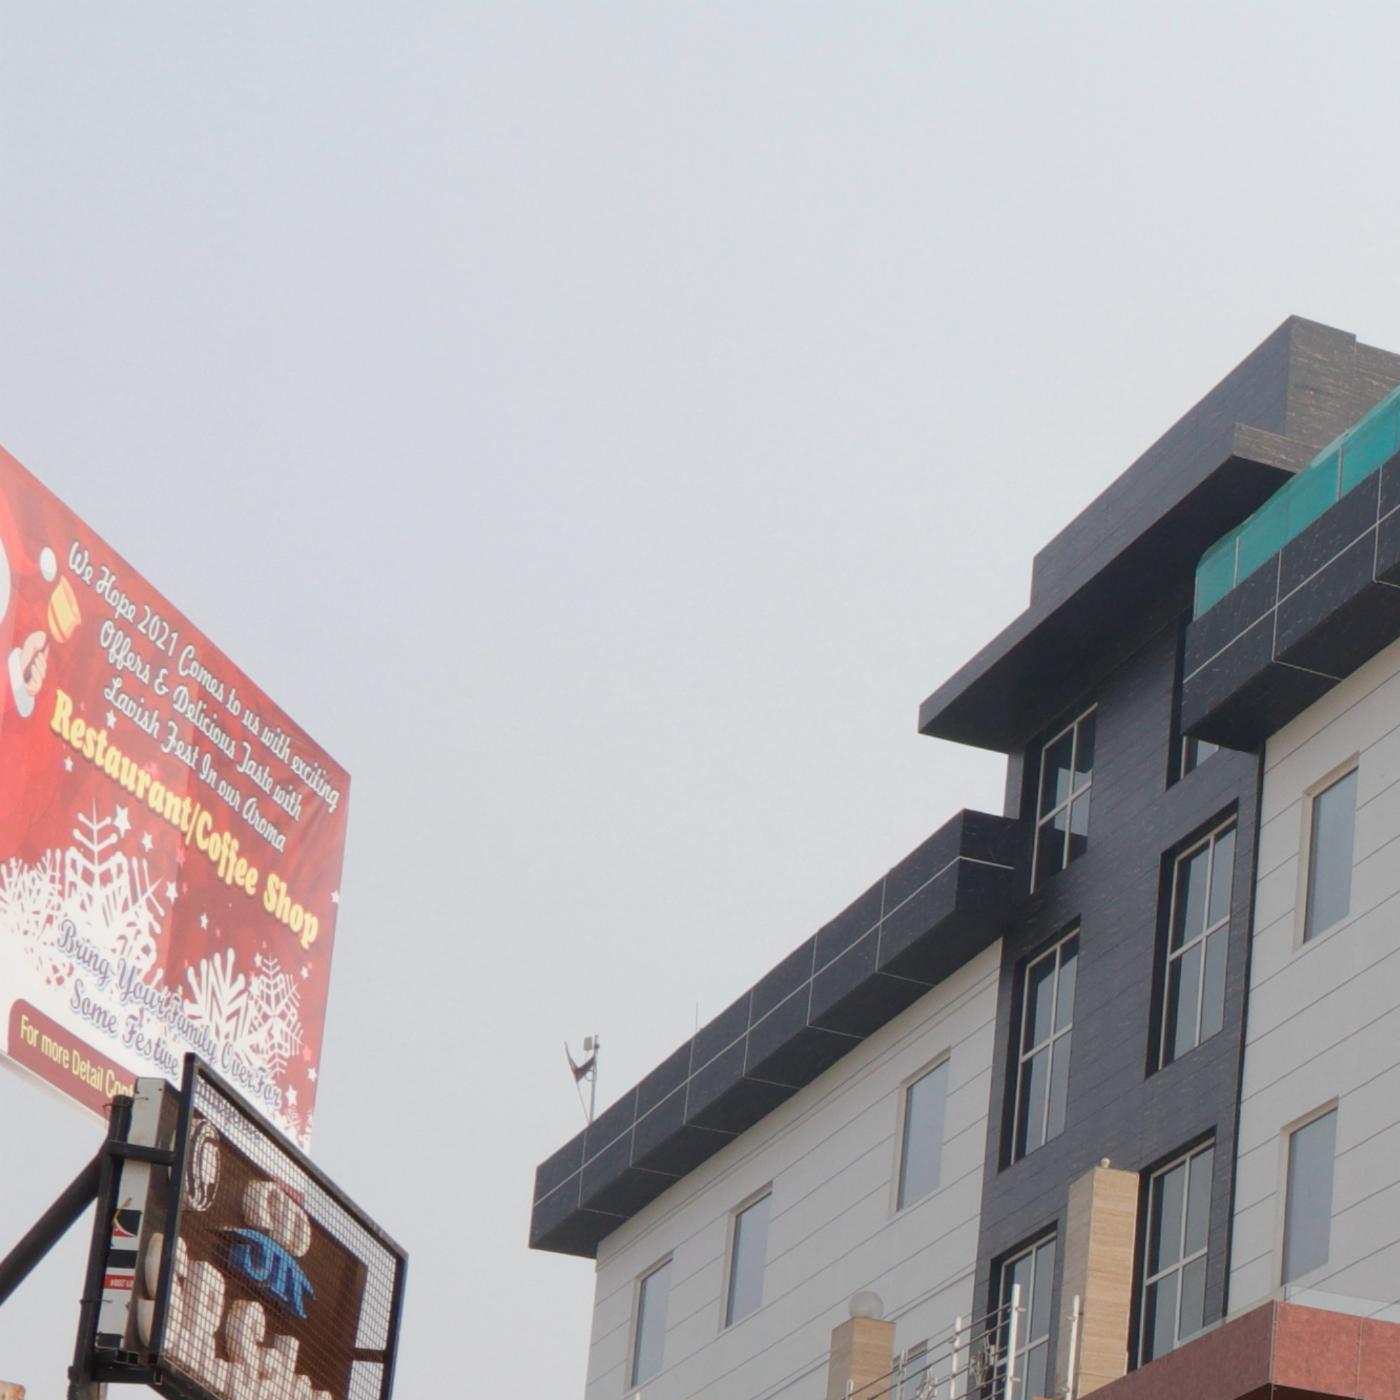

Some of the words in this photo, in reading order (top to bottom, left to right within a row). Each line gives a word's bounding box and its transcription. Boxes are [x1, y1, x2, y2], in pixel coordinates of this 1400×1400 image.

[69, 541, 93, 585] We
[96, 566, 136, 624] Hope
[137, 605, 178, 657] 2021
[178, 645, 225, 703] Comes
[225, 688, 241, 716] to
[242, 707, 260, 736] us
[261, 727, 291, 764] with
[290, 755, 340, 814] exciting
[100, 620, 150, 685] Offers
[154, 668, 168, 695] &
[173, 685, 236, 760] Delicious
[236, 742, 273, 794] Taste
[272, 785, 304, 821] with
[104, 677, 160, 739] Lavish
[161, 721, 200, 770] Fest
[217, 780, 241, 812] our
[242, 797, 287, 852] Aroma
[57, 919, 110, 984] Bring
[263, 873, 319, 950] Shop
[20, 1014, 39, 1047] For
[41, 1035, 70, 1069] more
[72, 1049, 104, 1092] Detail
[70, 978, 117, 1034] Some
[122, 1014, 179, 1076] Festive
